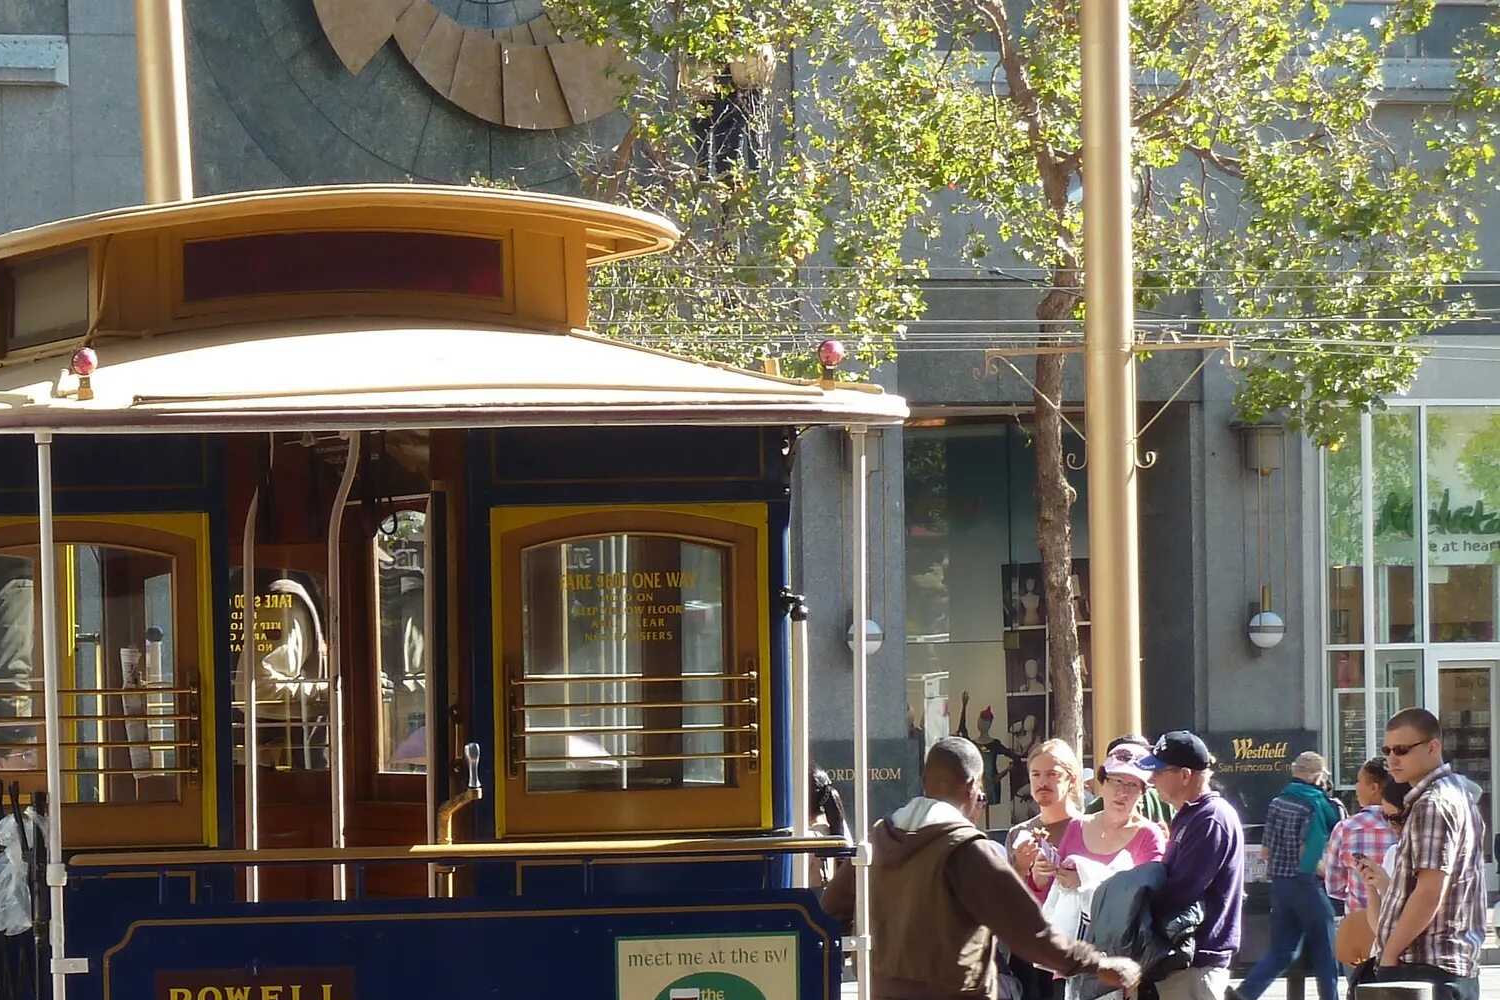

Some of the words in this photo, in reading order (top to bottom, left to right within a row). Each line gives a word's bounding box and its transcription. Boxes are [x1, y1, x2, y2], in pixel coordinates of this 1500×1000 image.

[632, 572, 662, 588] ONE
[637, 592, 653, 601] ON
[648, 604, 682, 615] FLOOR
[1232, 737, 1288, 759] Westfield
[1218, 762, 1233, 773] San
[1235, 762, 1273, 773] Francisco
[678, 952, 704, 966] me
[708, 951, 726, 965] at
[731, 948, 759, 964] the
[765, 948, 788, 963] BV!
